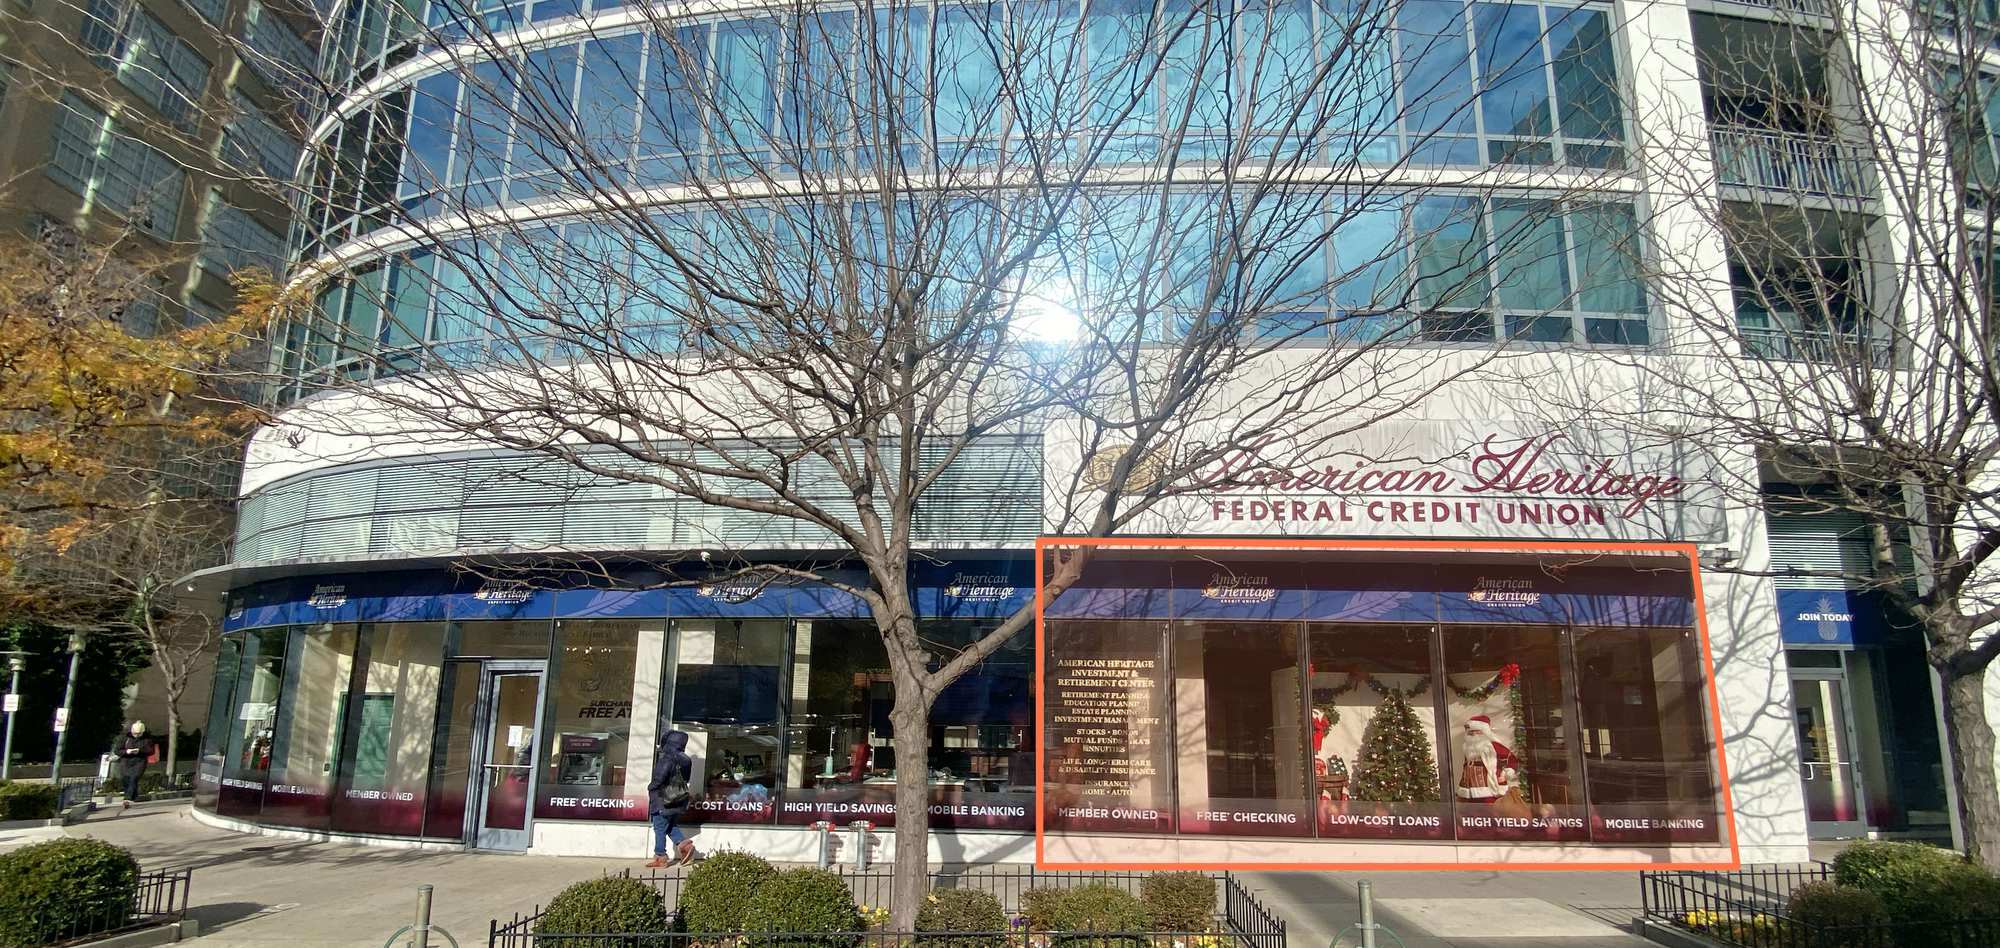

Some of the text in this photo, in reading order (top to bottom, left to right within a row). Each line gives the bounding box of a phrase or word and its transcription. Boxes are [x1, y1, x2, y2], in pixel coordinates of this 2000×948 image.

[1164, 432, 1687, 519] American Heritage
[1212, 500, 1605, 526] FEDERAL CREDIT UNION
[950, 572, 1009, 585] American
[1206, 572, 1269, 585] American
[1472, 576, 1533, 591] American
[961, 584, 1015, 600] Heritage
[1219, 585, 1276, 602] Heritage
[1486, 588, 1540, 606] Heritage
[1797, 613, 1854, 622] JOIN TODAY
[1058, 659, 1154, 668] AMERICAN HERITAGE
[1071, 669, 1130, 677] INVESTMENT
[1058, 679, 1155, 688] RETIREMENT CENTER
[578, 707, 614, 718] FREE
[1104, 717, 1160, 725] MANAMENT
[1076, 728, 1106, 736] STOCKS
[1110, 767, 1156, 775] INSURANCE
[346, 789, 413, 801] MEMBER OWNED
[581, 798, 634, 808] CHECKING
[726, 802, 763, 811] LOANS
[784, 802, 812, 812] HIGH
[815, 803, 848, 813] YIELD
[971, 806, 1025, 816] BANKING
[1058, 808, 1159, 820] MEMBER OWNED
[1233, 813, 1297, 823] CHECKING
[1331, 814, 1440, 827] LOW-COST LOANS
[1461, 817, 1583, 829] HIGH YIELD SAVINGS
[1605, 818, 1705, 830] MOBILE BANKING
